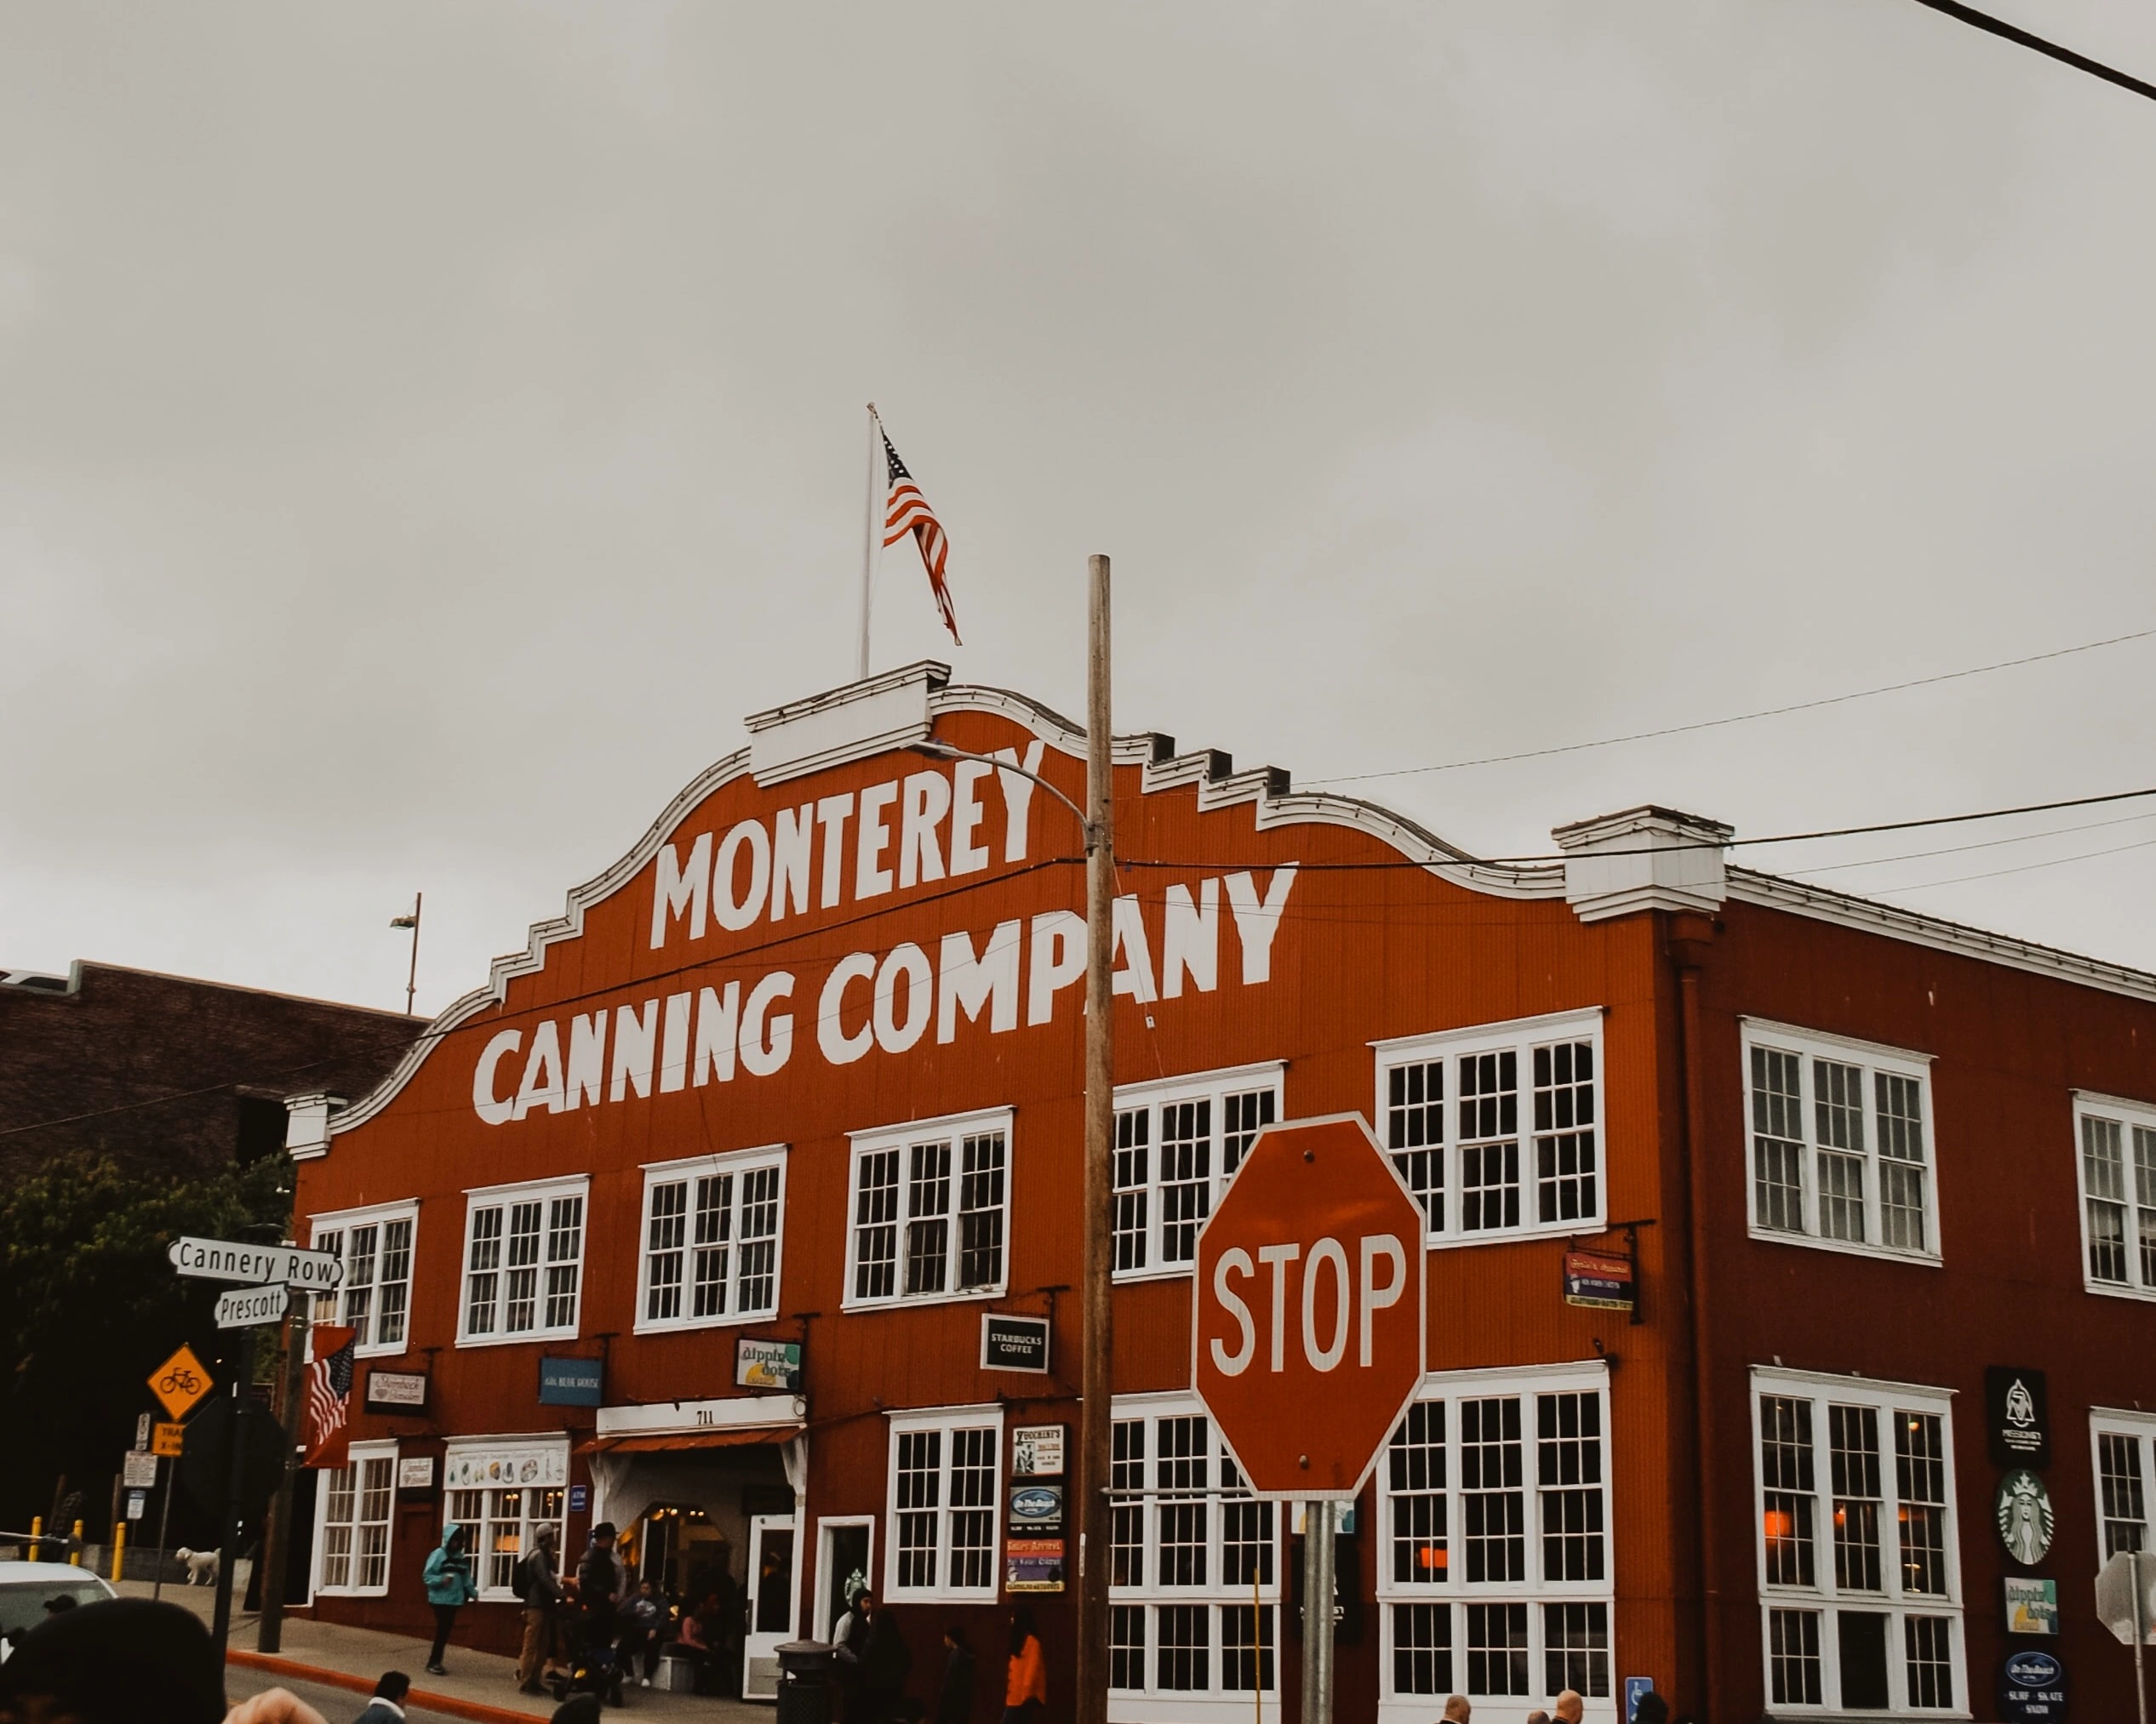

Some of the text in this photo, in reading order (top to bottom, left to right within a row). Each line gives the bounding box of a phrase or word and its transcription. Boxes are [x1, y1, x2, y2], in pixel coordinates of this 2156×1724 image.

[650, 739, 1044, 950] MONTEREY
[472, 860, 1300, 1125] CANNING COMPANY
[180, 1242, 333, 1282] Cannery Row
[220, 1290, 281, 1321] Prescott
[1210, 1234, 1406, 1377] STOP
[992, 1333, 1042, 1345] STARBUCKS
[1000, 1344, 1032, 1354] COFFEE
[762, 1362, 791, 1377] dots
[558, 1377, 575, 1387] BLUE
[577, 1378, 599, 1389] HOUSE
[697, 1411, 713, 1425] 711
[163, 1427, 180, 1436] TRA
[2027, 1601, 2050, 1619] dots
[2009, 1691, 2063, 1701] SURF SKATE
[2026, 1704, 2049, 1714] SNOW
